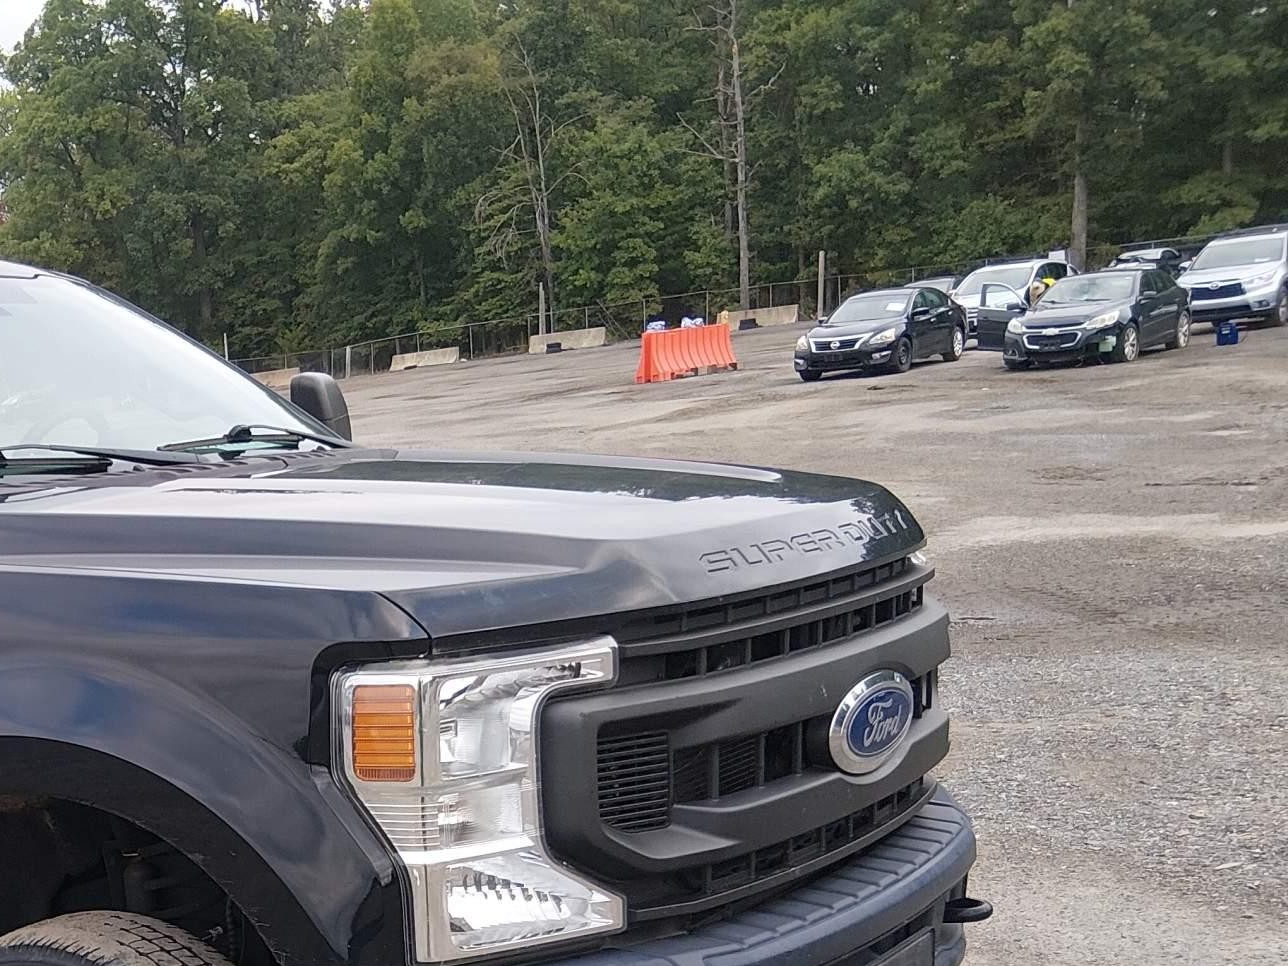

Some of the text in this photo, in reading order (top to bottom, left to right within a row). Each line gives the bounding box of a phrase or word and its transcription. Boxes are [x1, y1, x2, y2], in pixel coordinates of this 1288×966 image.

[698, 508, 908, 574] SUPER DUTY
[863, 699, 902, 747] Ford
